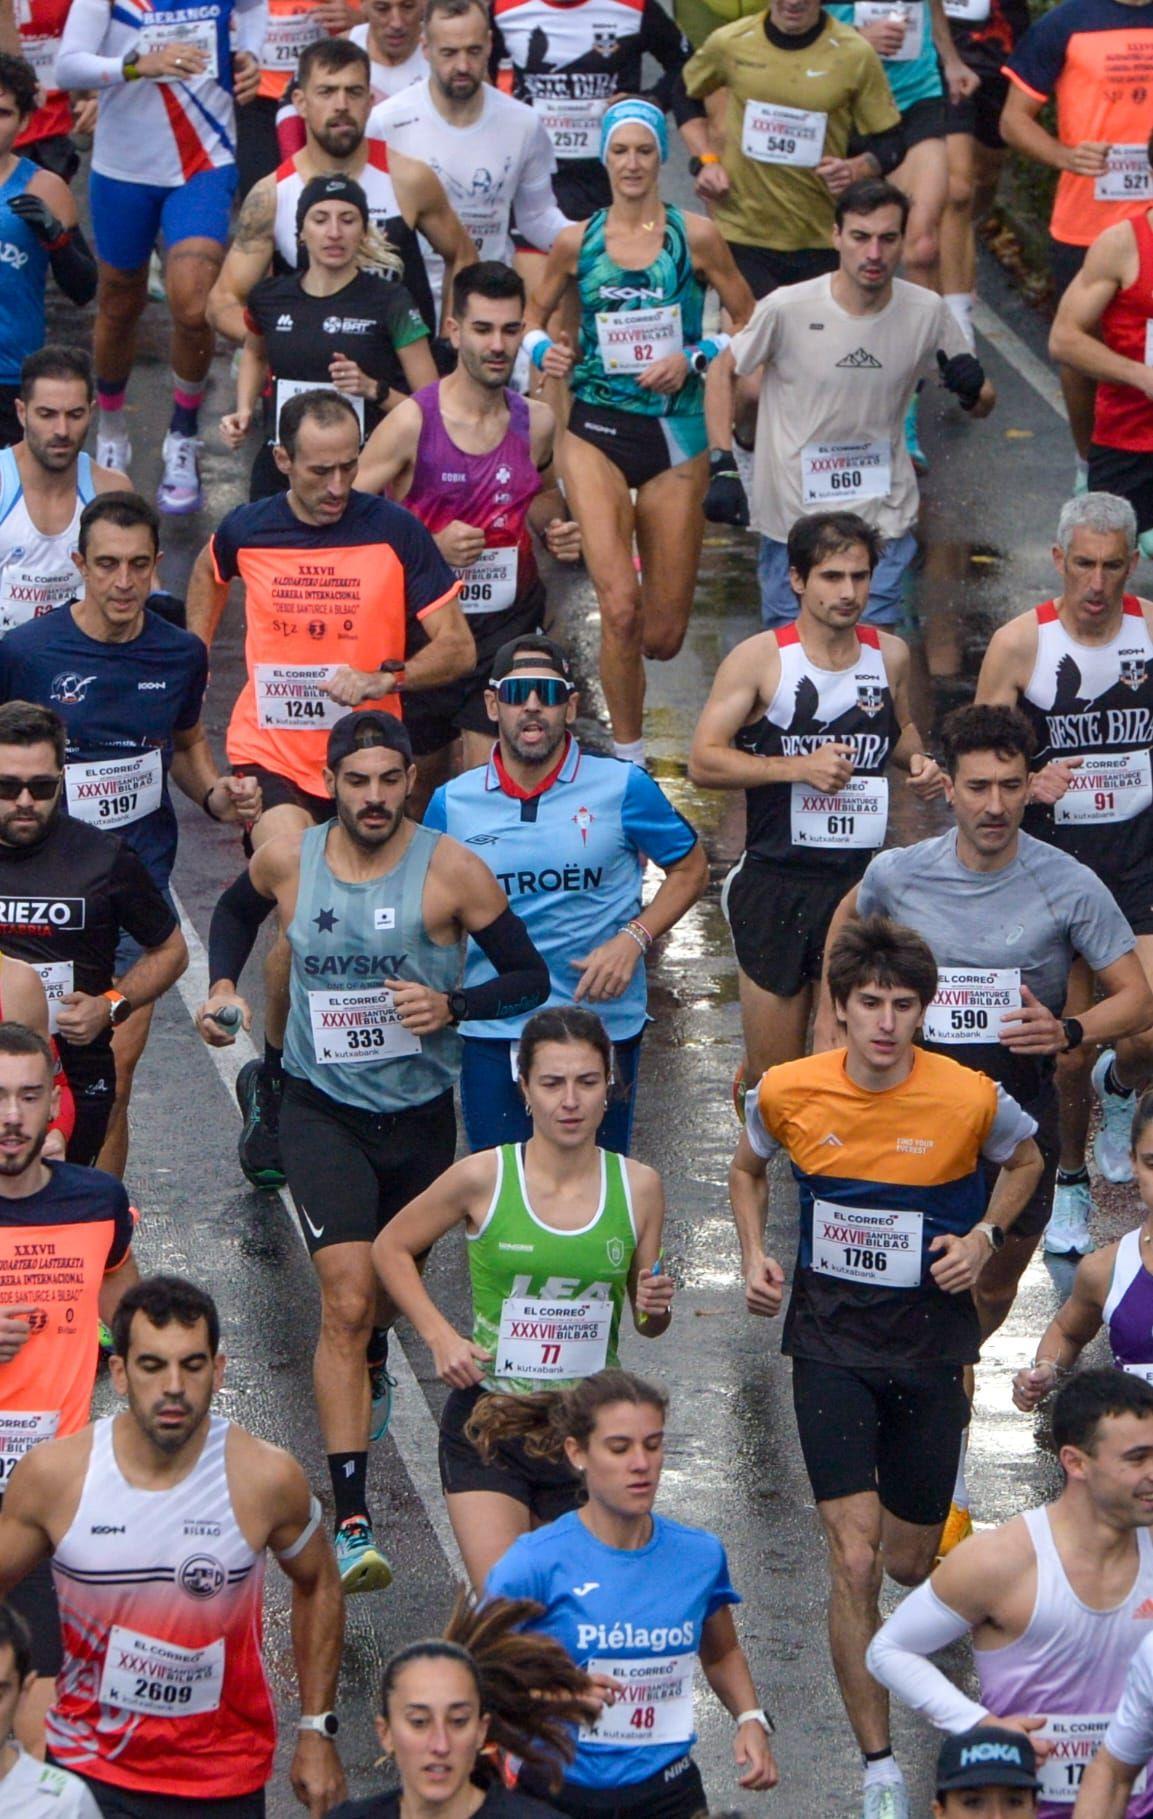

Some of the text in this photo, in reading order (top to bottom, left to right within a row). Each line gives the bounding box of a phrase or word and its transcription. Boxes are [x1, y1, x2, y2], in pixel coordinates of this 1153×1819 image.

[554, 132, 588, 146] 2572
[767, 137, 796, 154] 549
[1123, 174, 1149, 189] 521
[634, 344, 653, 361] 82
[831, 471, 861, 489] 660
[22, 574, 70, 583] EL CORREO
[299, 566, 335, 576] XXXVII
[273, 670, 326, 679] EL CORREO
[285, 701, 325, 718] 1244
[1046, 711, 1103, 749] BESTE
[86, 763, 141, 777] EL CORREO
[1085, 759, 1127, 769] CORREO
[1103, 771, 1140, 781] SANTURCE
[1103, 778, 1141, 788] BILBAO
[76, 781, 117, 799] XXXVII
[118, 777, 153, 793] BILBAO
[98, 793, 138, 817] 3197
[802, 797, 842, 811] XXXVII
[842, 804, 878, 812] BILBAO
[1094, 792, 1115, 811] 91
[828, 815, 854, 835] 611
[496, 863, 603, 896] TROËN
[303, 954, 409, 976] SAYSKY
[951, 975, 995, 984] CORREO
[329, 995, 387, 1006] EL CORREO
[969, 990, 1010, 998] SANTURCE
[969, 997, 1010, 1006] BILBAO
[320, 1012, 363, 1026] XXXVII
[951, 1009, 988, 1030] 590
[346, 1028, 385, 1049] 333
[833, 1211, 894, 1226] EL CORREO
[823, 1223, 865, 1245] XXXVII
[865, 1231, 910, 1241] SANTURCE
[15, 1243, 55, 1256] XXXVII
[865, 1239, 910, 1249] BILBAO
[843, 1246, 887, 1272] 1786
[24, 1273, 84, 1285] INTERNACIONAL
[511, 1275, 613, 1300] LEA
[524, 1306, 586, 1317] EL CORREO
[510, 1322, 555, 1339] XXXVII
[556, 1323, 599, 1331] SANTURCE
[556, 1330, 598, 1339] BILBAO
[541, 1343, 561, 1365] 77
[184, 1527, 221, 1538] BILBAO
[576, 1621, 695, 1652] PiélagoS
[134, 1640, 200, 1662] EL CORREO
[119, 1652, 166, 1678] XXXVII
[613, 1665, 674, 1678] EL CORREO
[134, 1679, 193, 1704] 2609
[630, 1706, 656, 1729] 48
[1053, 1724, 1066, 1733] EL
[960, 1742, 1022, 1767] HOKA
